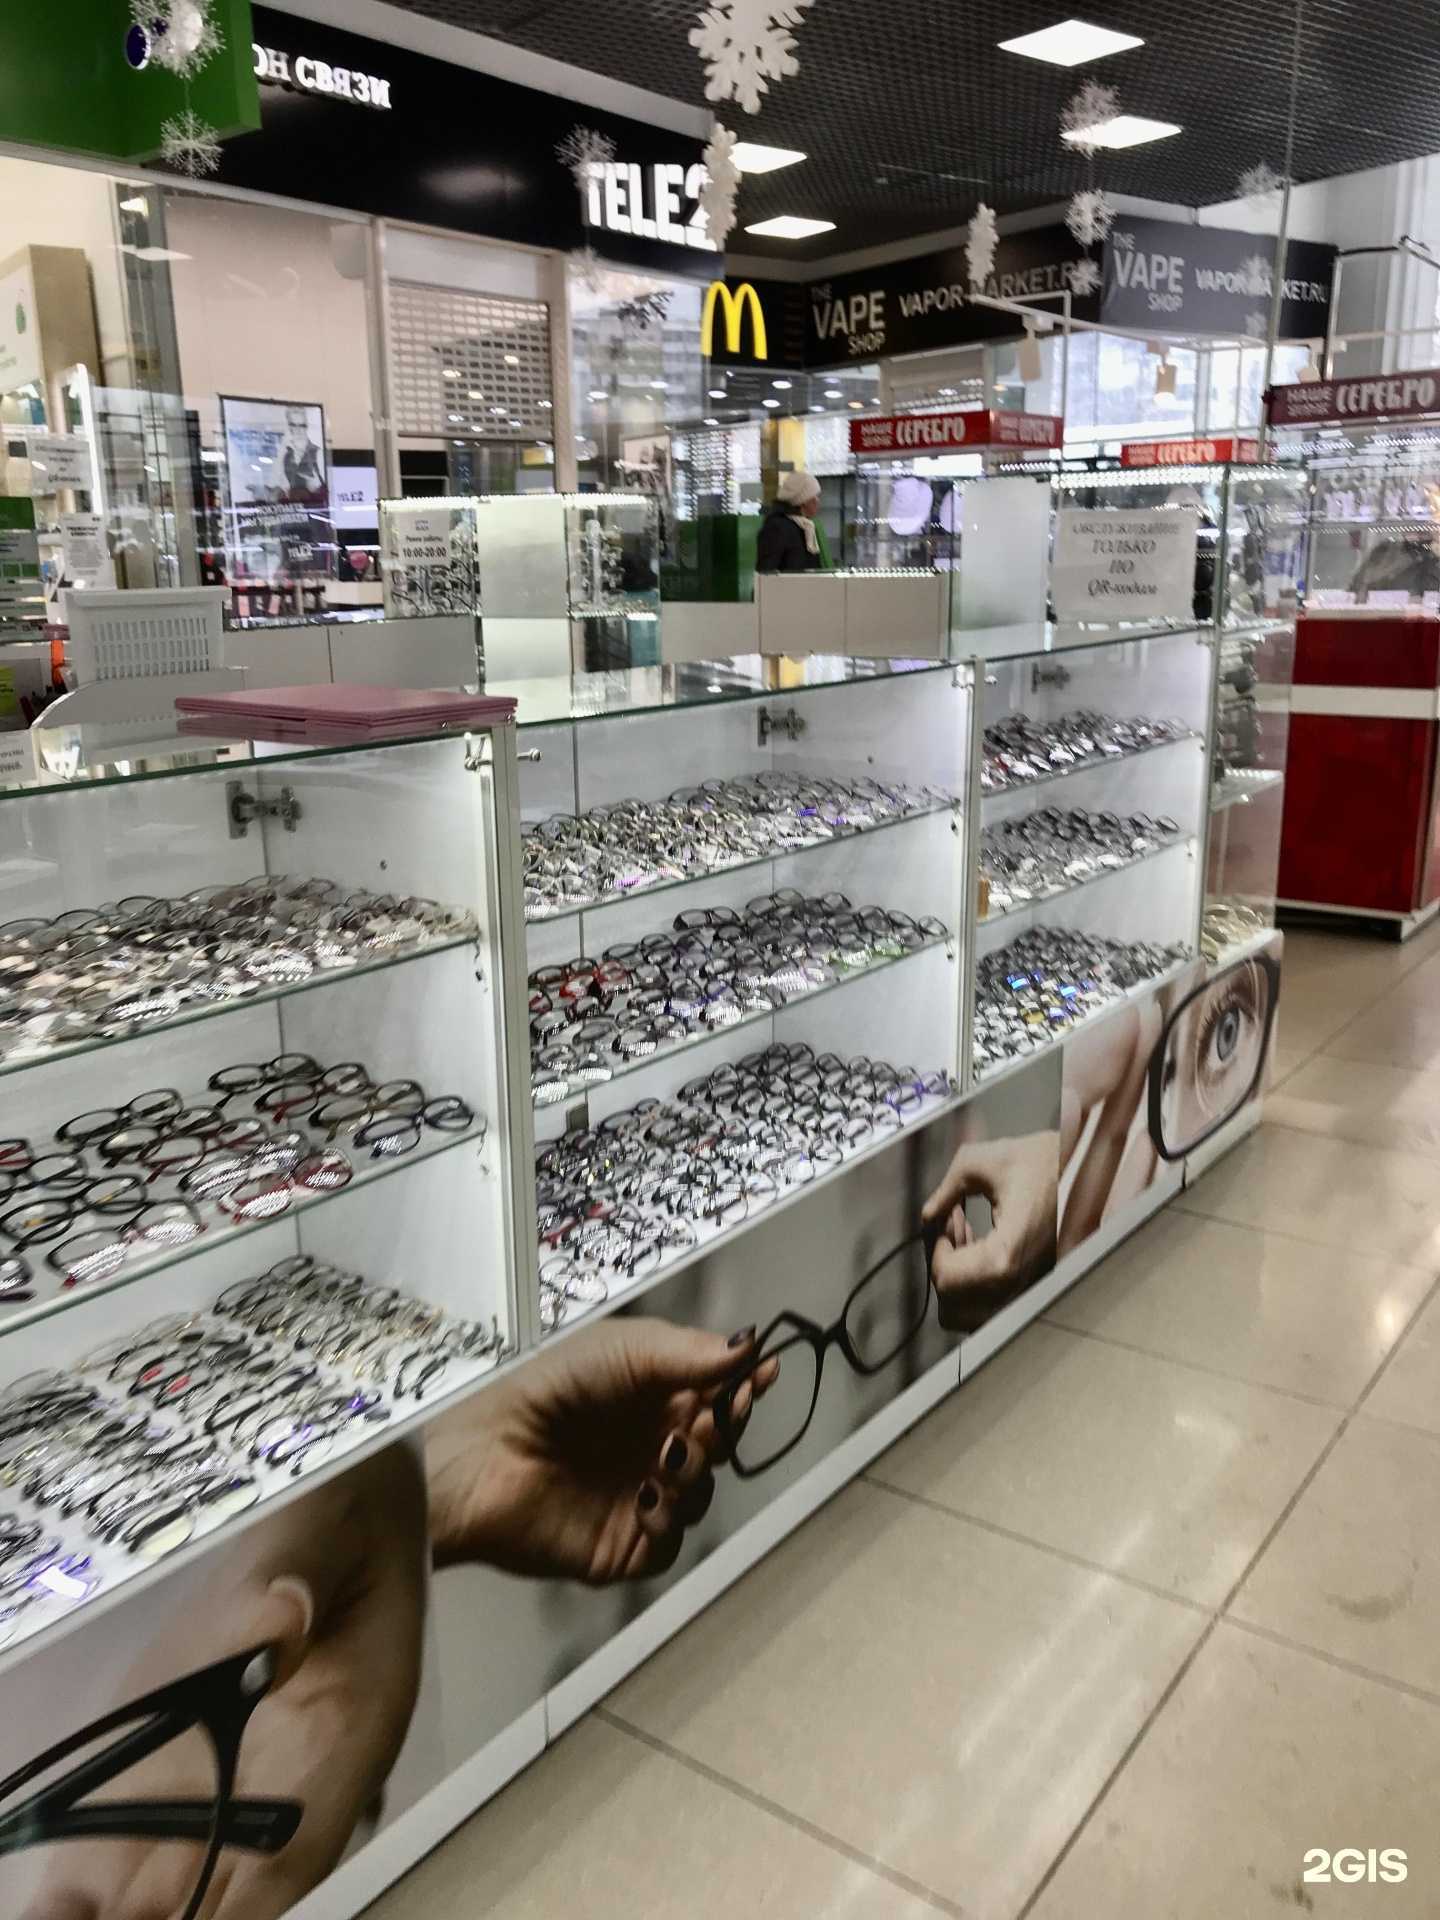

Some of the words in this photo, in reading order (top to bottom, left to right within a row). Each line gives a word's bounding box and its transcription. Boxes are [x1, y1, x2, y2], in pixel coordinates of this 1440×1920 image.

[295, 56, 391, 109] СВЯЗИ
[586, 162, 717, 252] TELE2
[1114, 250, 1184, 294] VAPE
[813, 290, 886, 340] VAPE
[1148, 293, 1184, 313] SHOP
[848, 331, 887, 354] SHOP
[1335, 377, 1436, 415] СЕРЕБРО
[896, 415, 966, 446] СЕРЕБРО
[1092, 539, 1158, 555] ТОЛЬКО
[1108, 559, 1136, 575] ПО
